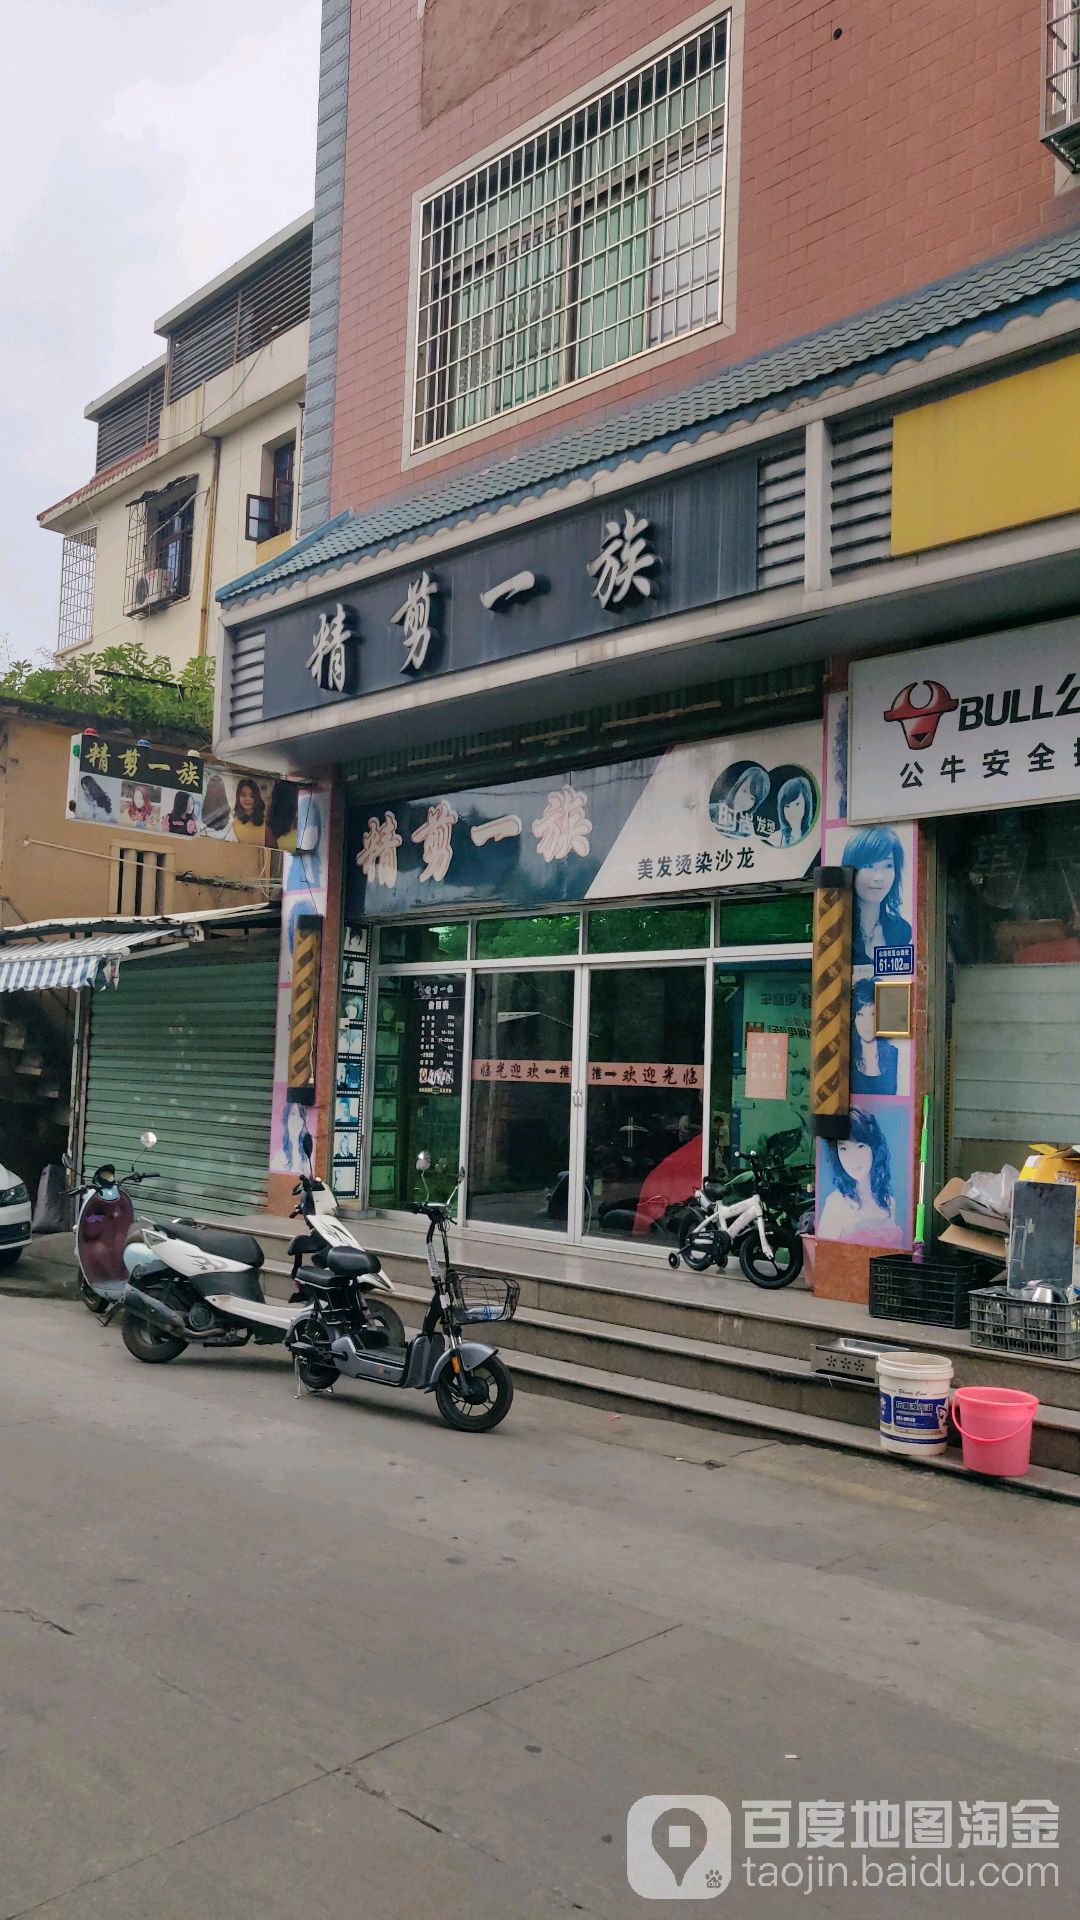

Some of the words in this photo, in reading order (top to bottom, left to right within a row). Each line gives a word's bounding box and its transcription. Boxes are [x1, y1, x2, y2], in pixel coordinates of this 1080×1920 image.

[306, 508, 657, 693] 精剪一族
[84, 742, 200, 787] 精剪一族
[900, 737, 1080, 789] 公牛安全
[356, 784, 593, 889] 精剪一族
[637, 847, 755, 880] 美发烫染沙龙
[622, 1065, 699, 1086] 欢迎光临
